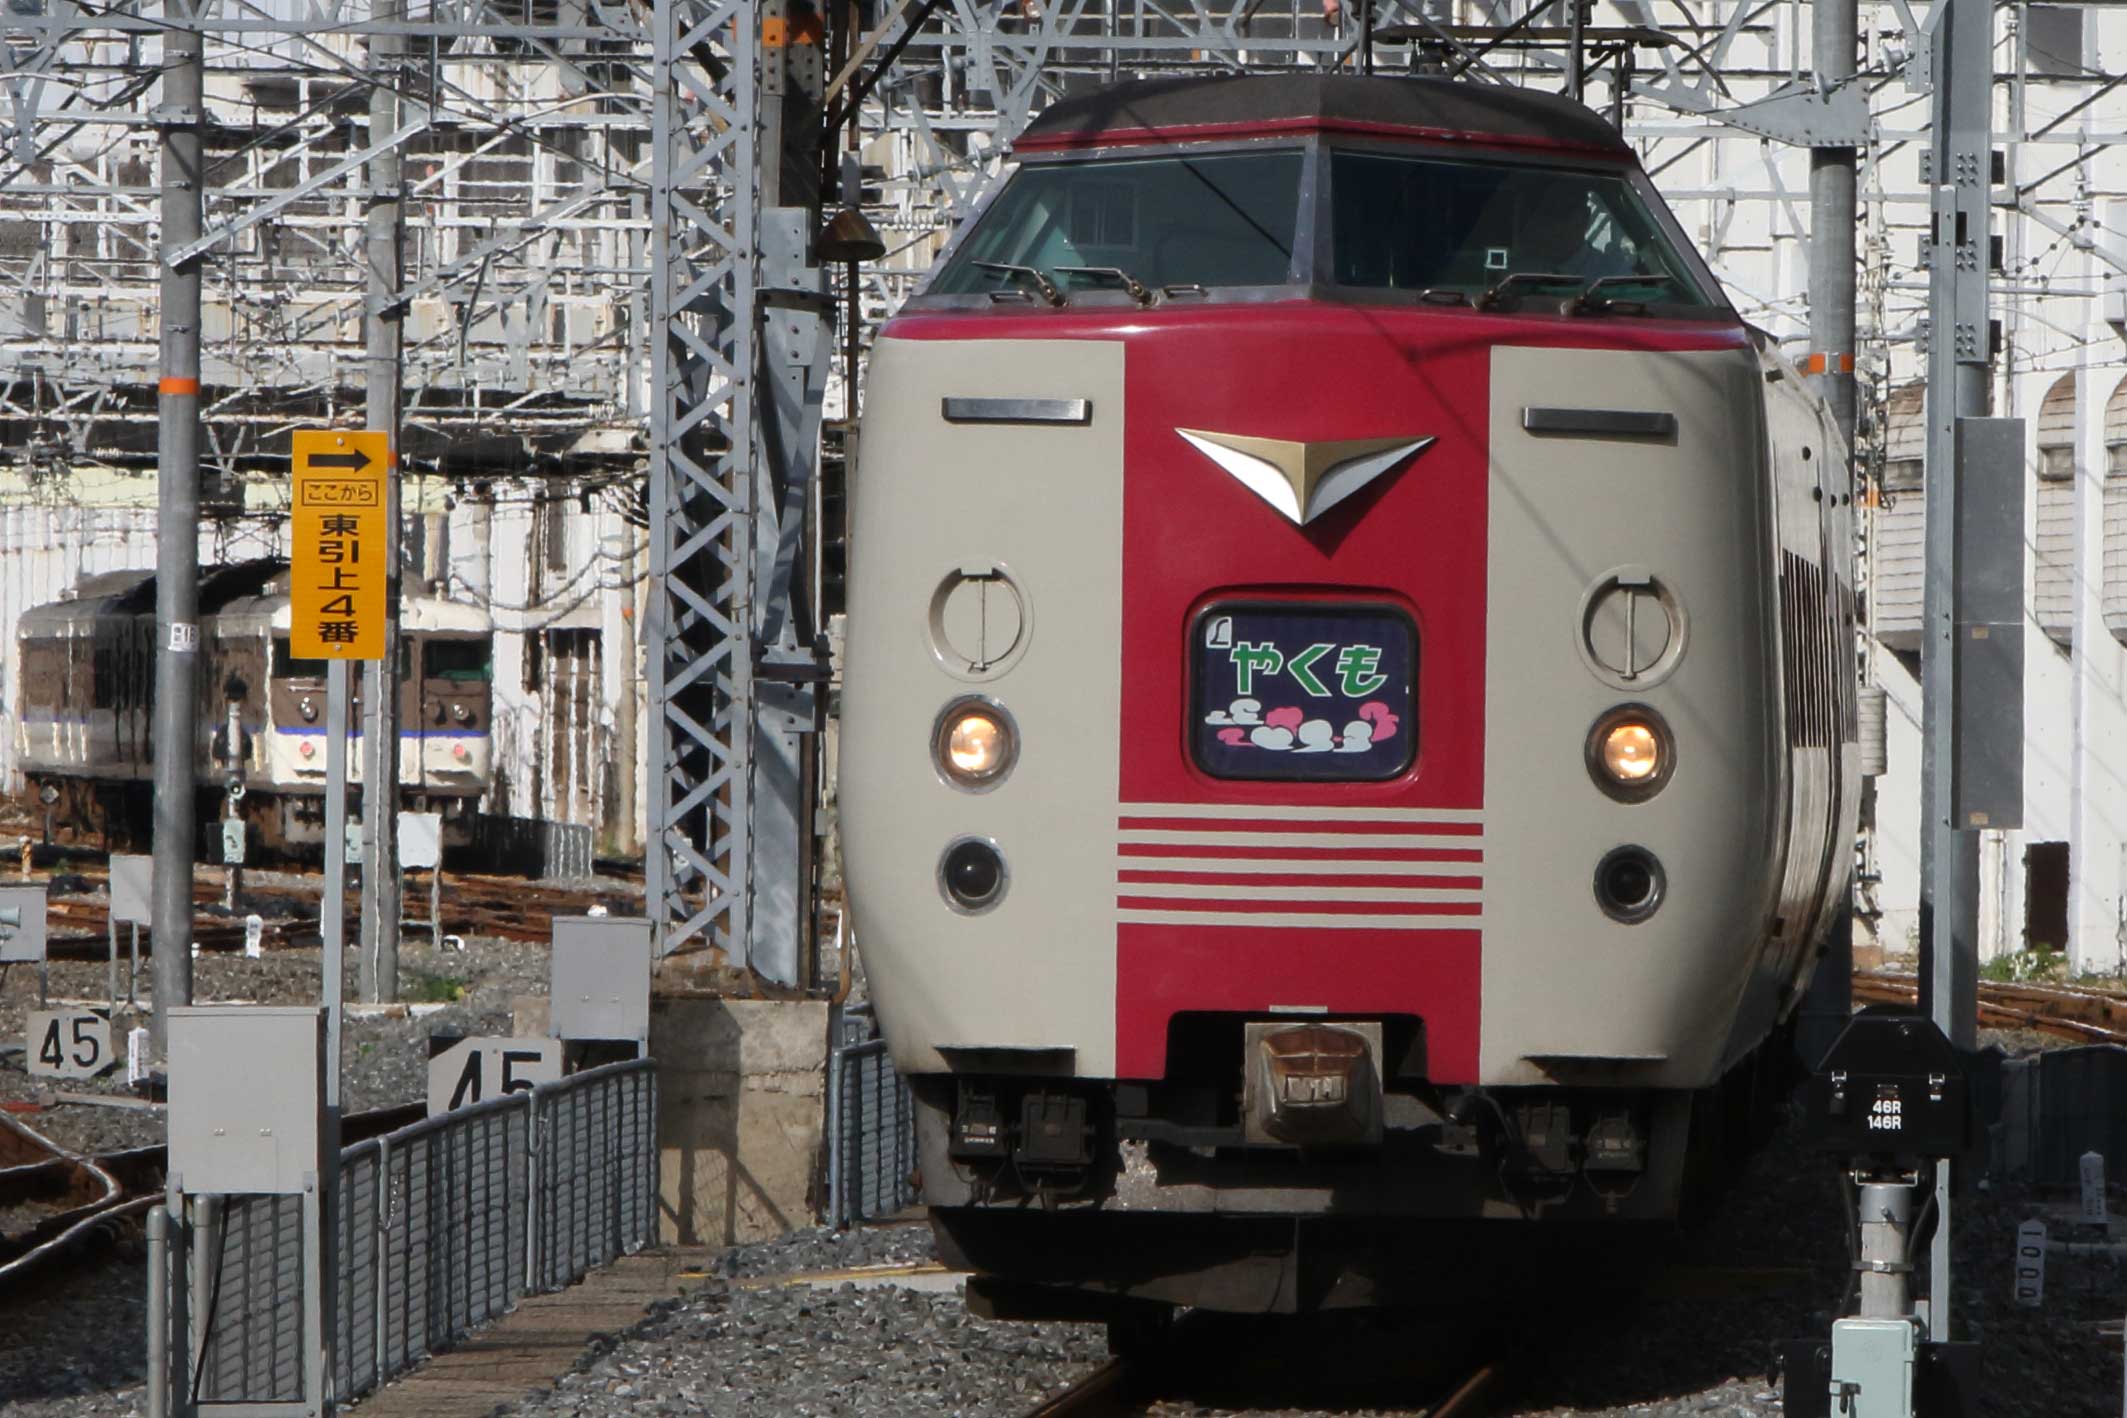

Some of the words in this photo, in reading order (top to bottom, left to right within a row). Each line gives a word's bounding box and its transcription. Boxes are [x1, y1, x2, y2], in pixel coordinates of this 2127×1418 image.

[308, 484, 373, 501] ここから
[317, 513, 361, 644] 東引上4番
[1229, 641, 1388, 698] やくも
[39, 1016, 99, 1070] 45
[1867, 1114, 1902, 1130] 146R
[1872, 1099, 1902, 1114] 46R
